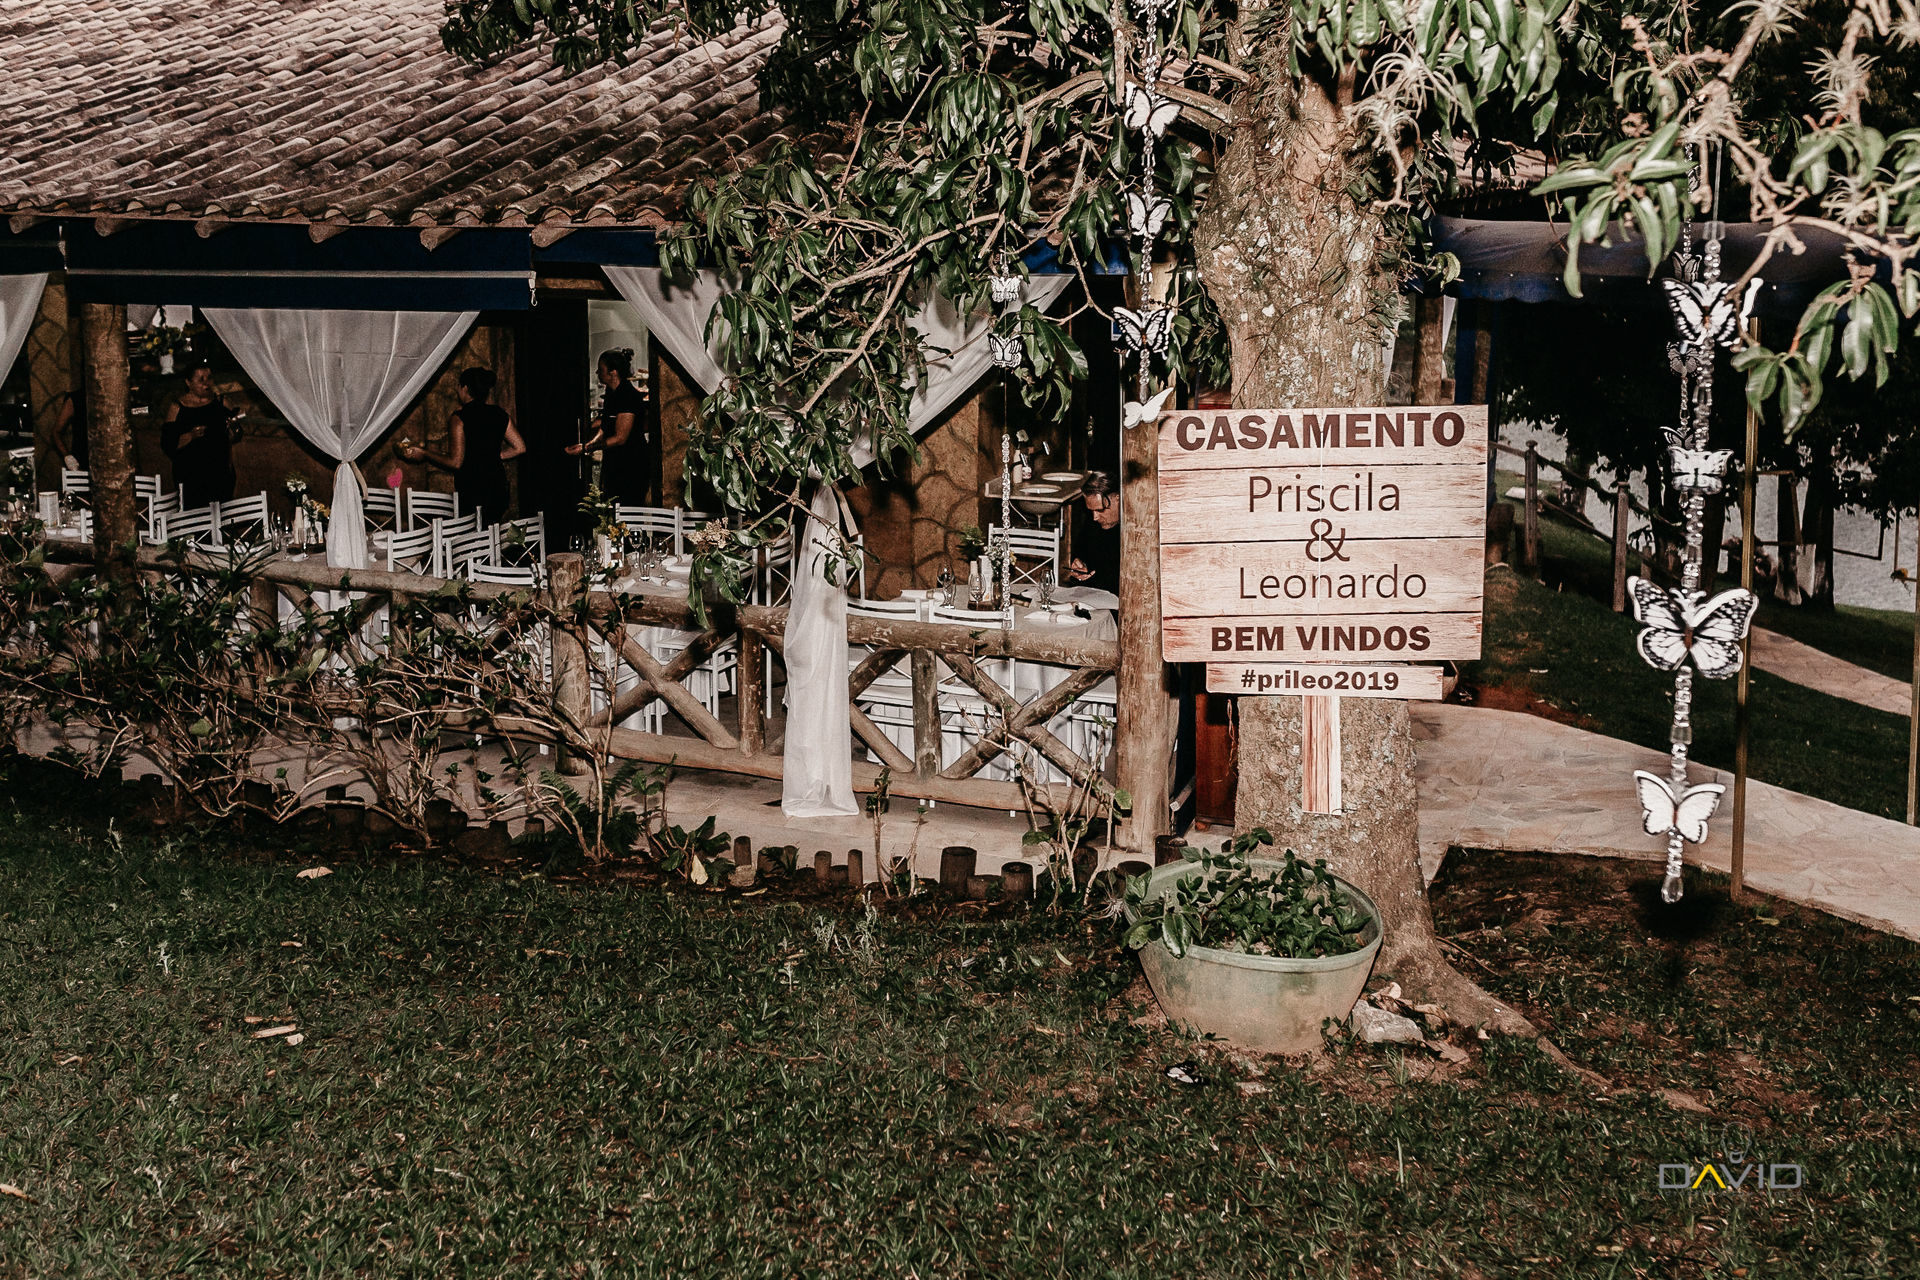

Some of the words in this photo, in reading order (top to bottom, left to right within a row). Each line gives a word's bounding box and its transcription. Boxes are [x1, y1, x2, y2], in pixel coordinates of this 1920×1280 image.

[1176, 411, 1465, 450] CASAMENTO
[1249, 472, 1400, 512] Priscila
[1305, 518, 1350, 562] &
[1240, 564, 1427, 600] Leonardo
[1211, 626, 1284, 651] BEM
[1296, 625, 1431, 651] VINDOS
[1240, 669, 1399, 691] #prileo2019
